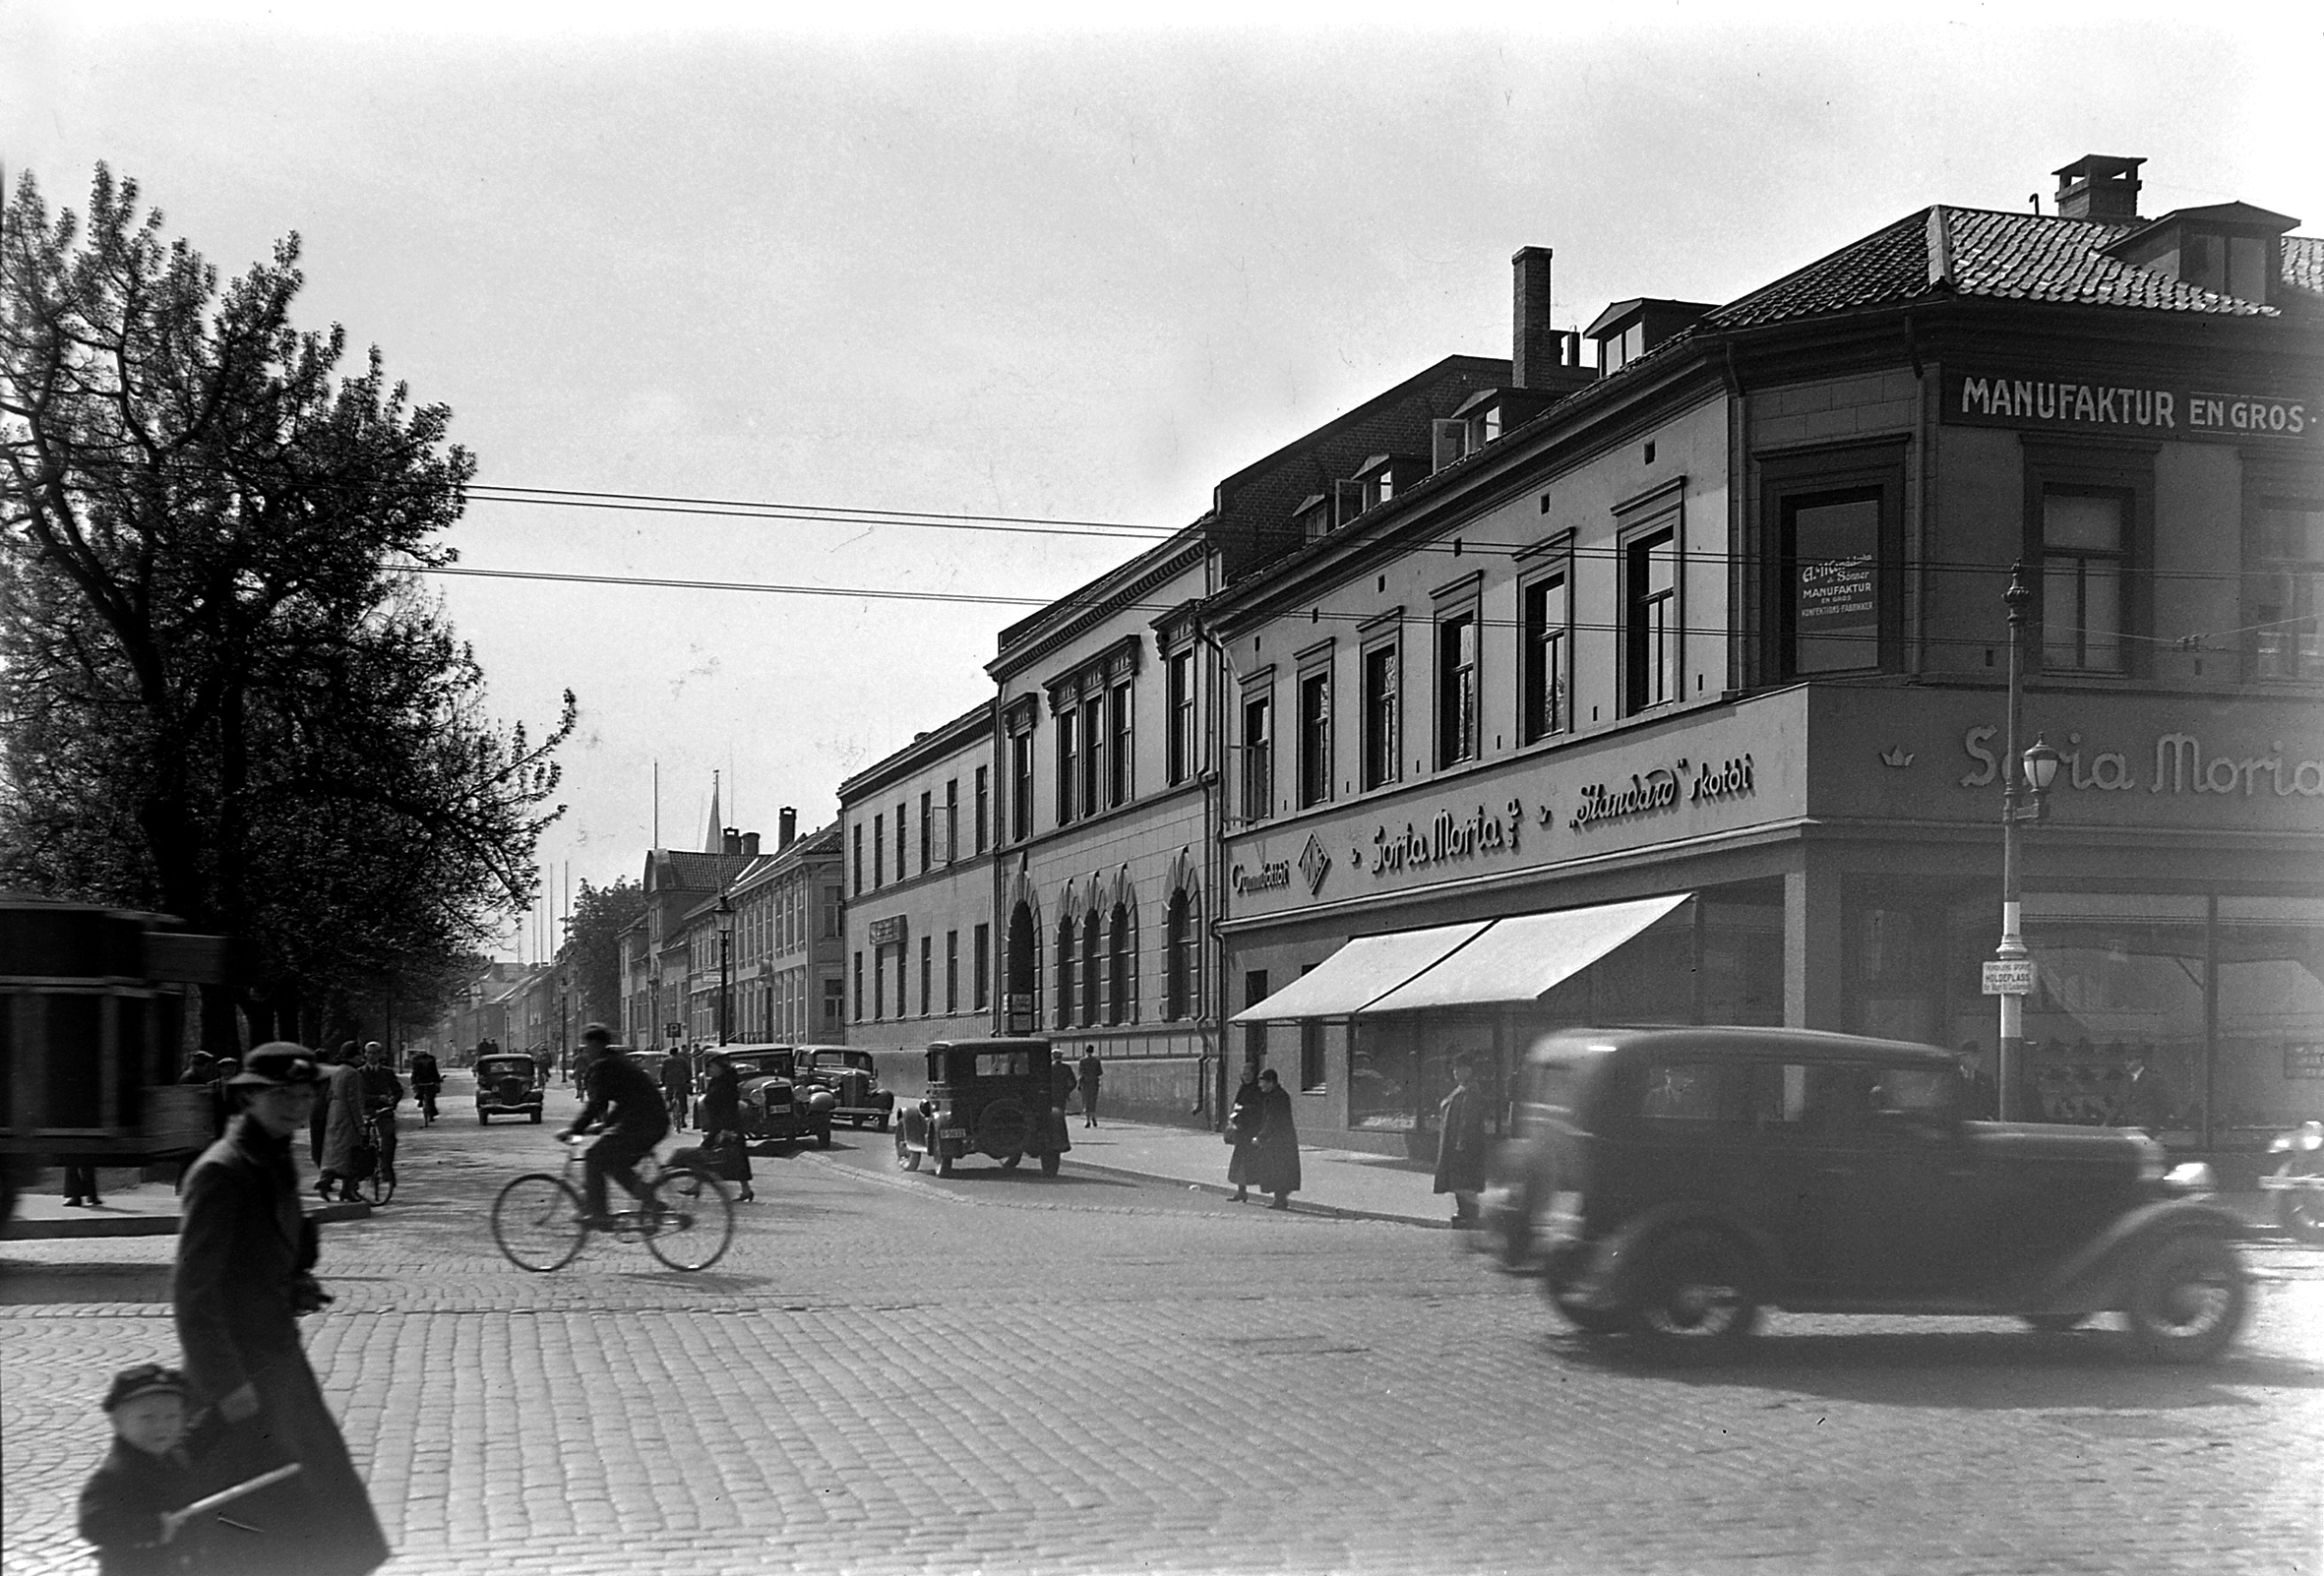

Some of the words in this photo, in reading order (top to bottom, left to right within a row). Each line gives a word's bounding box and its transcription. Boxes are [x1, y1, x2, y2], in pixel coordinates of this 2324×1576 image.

[1961, 376, 2176, 429] MANUFAKTUR
[2189, 397, 2225, 426] EN
[2230, 400, 2305, 433] GROS
[1803, 582, 1871, 599] MANUFAKTUR
[2151, 732, 2324, 797] Moria
[1372, 823, 1429, 875] Soria
[1431, 805, 1504, 862] Moria
[1985, 972, 2031, 983] HOLDEPLASS
